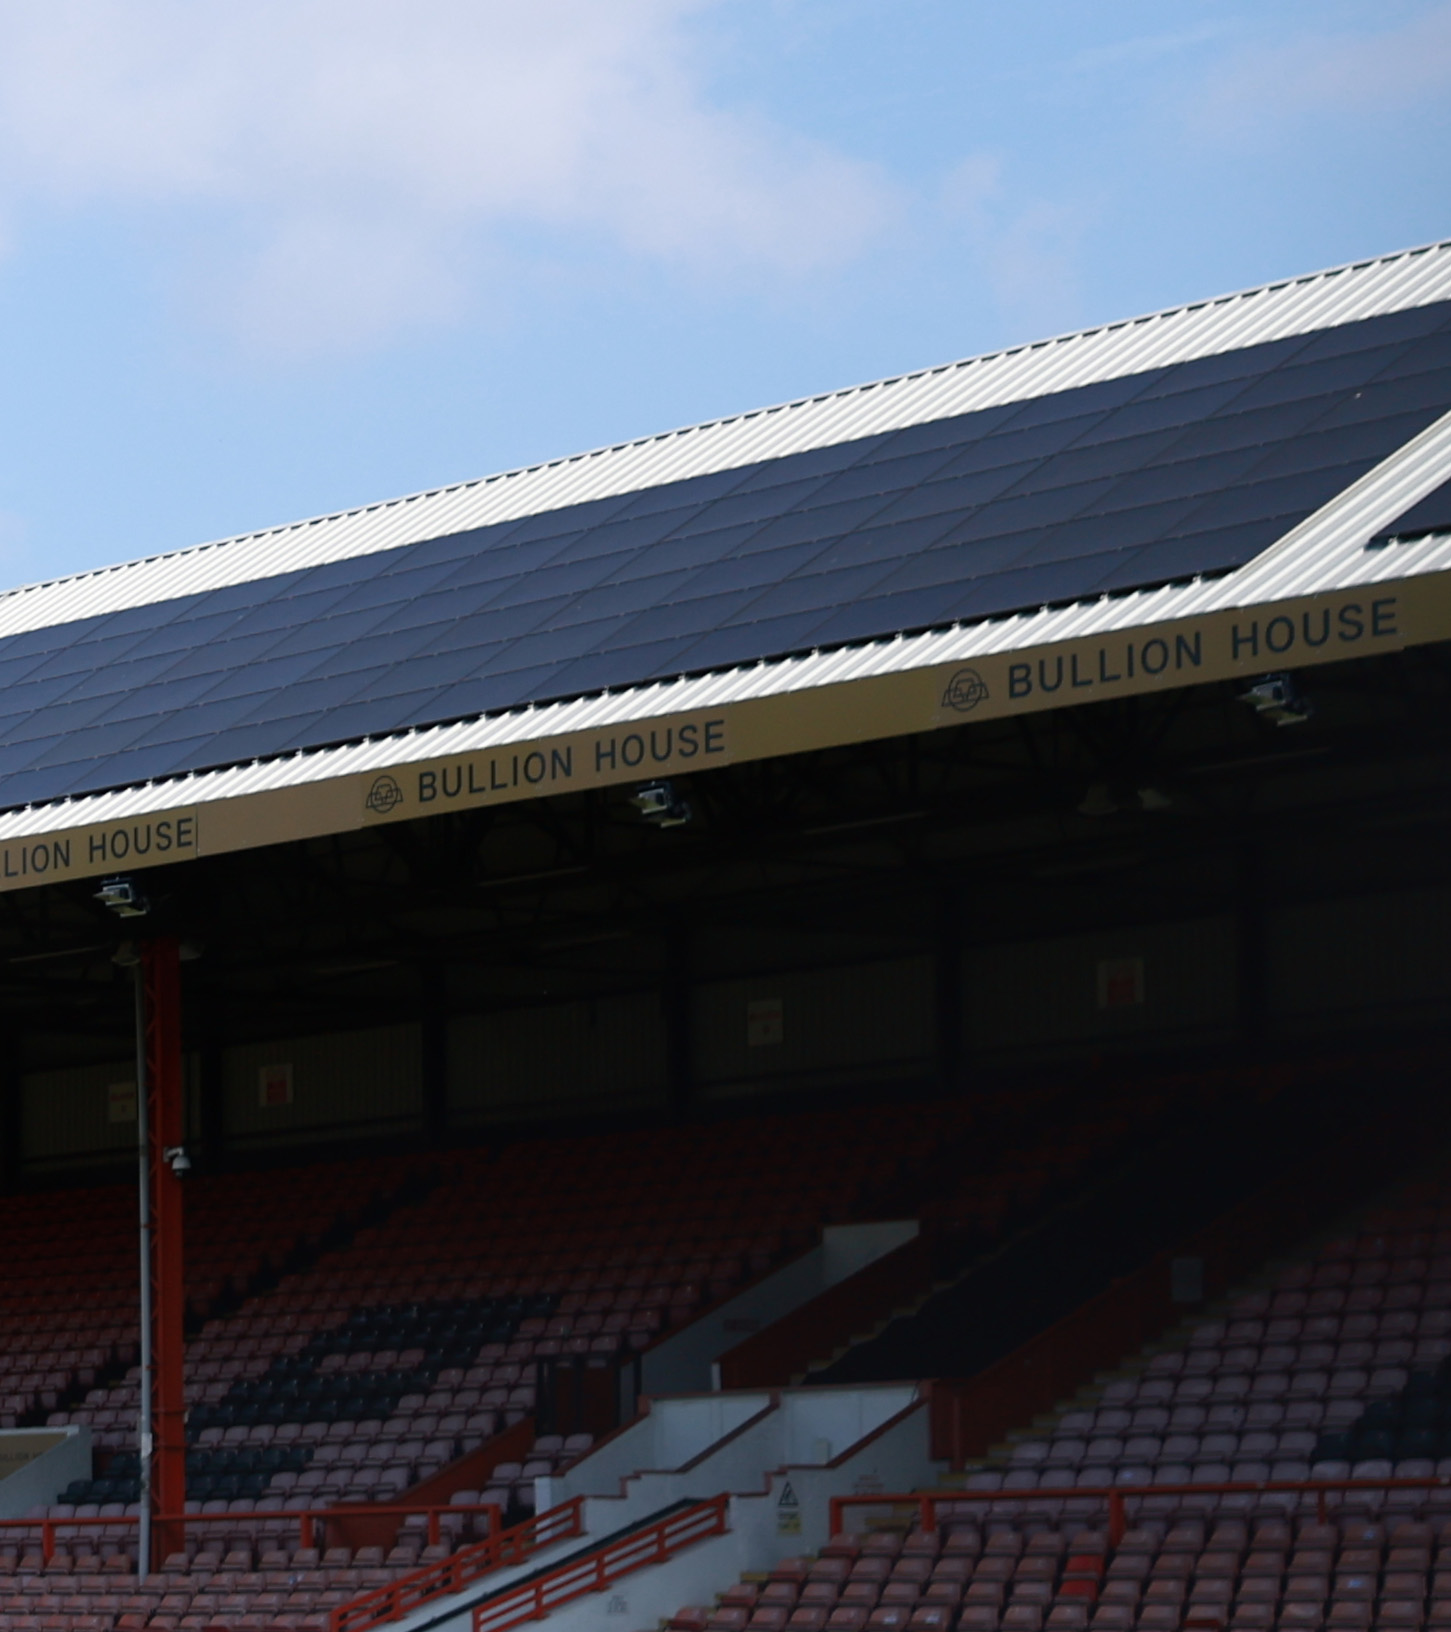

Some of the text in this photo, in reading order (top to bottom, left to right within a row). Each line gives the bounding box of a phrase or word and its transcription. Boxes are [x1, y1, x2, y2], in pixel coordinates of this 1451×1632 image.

[1009, 597, 1398, 699] BULLION HOUSE
[418, 720, 725, 802] BULLION HOUSE
[89, 818, 194, 863] HOUSE
